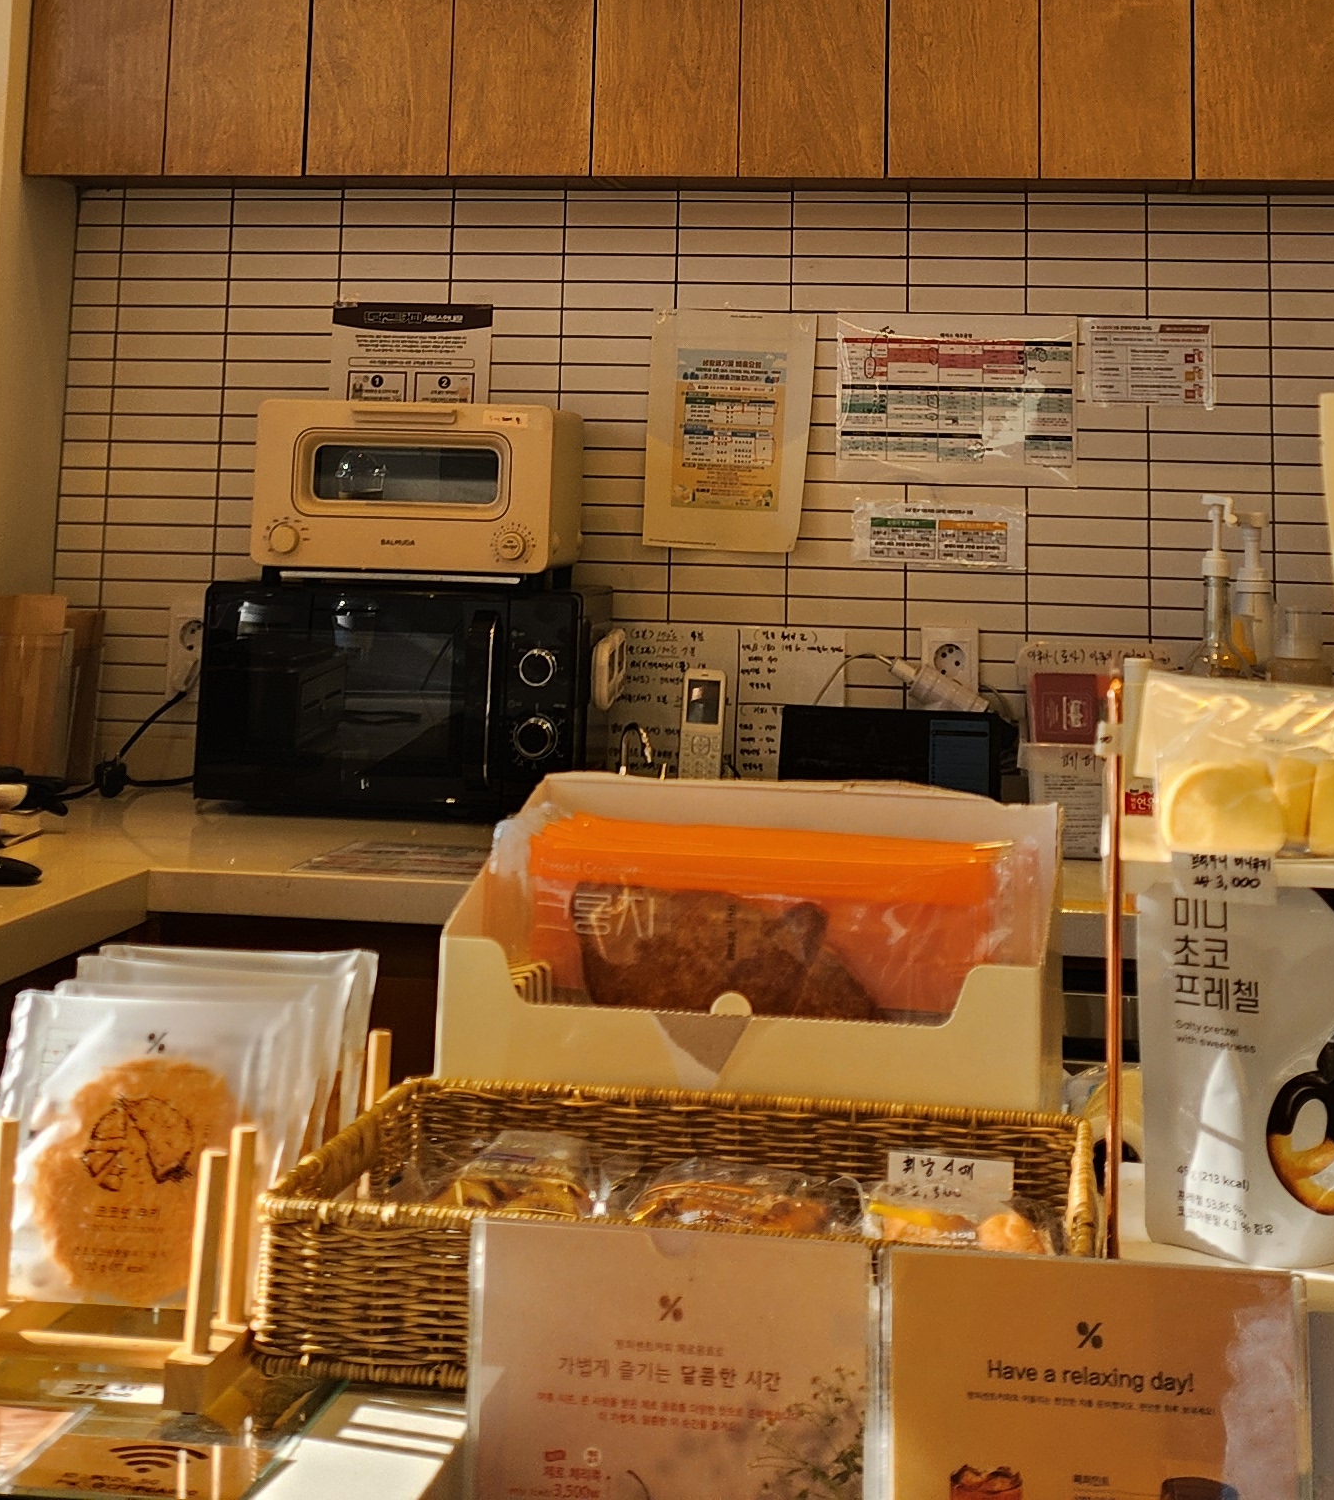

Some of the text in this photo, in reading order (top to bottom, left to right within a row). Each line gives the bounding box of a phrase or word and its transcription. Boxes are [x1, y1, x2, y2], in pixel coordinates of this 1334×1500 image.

[380, 538, 426, 547] BALMUDA
[1174, 897, 1228, 933] 미니
[1174, 934, 1230, 970] 초코
[1174, 974, 1260, 1015] 프레첼
[1175, 1019, 1240, 1038] Salty pretzel
[1176, 1034, 1257, 1055] with sweetness
[558, 1356, 781, 1393] 가볍게 즐기는 달콤한 시간
[987, 1359, 1195, 1397] Have a relaxing day!
